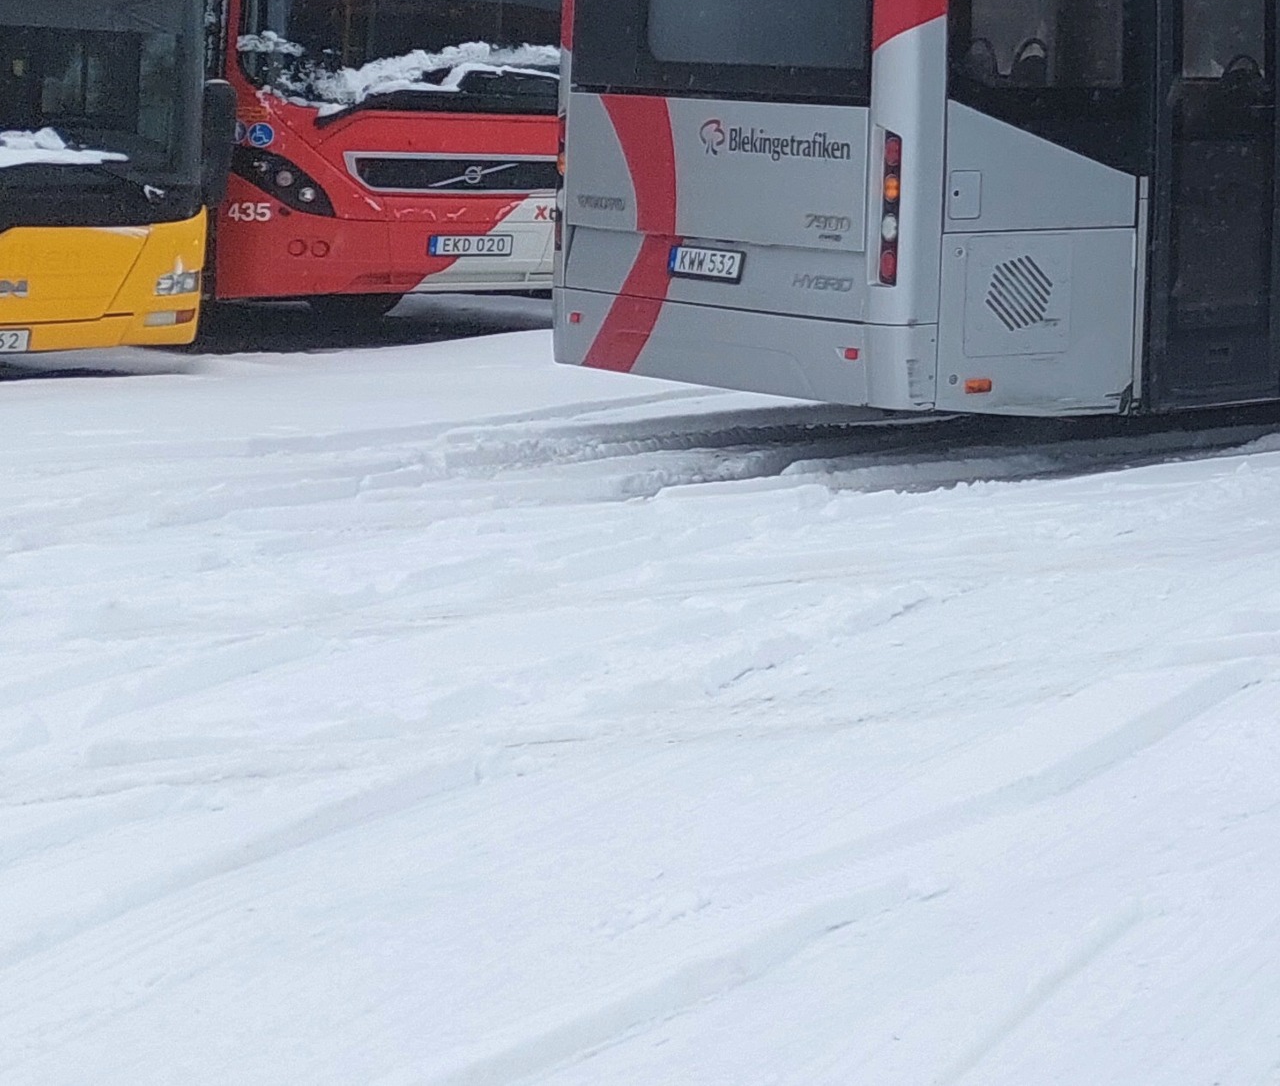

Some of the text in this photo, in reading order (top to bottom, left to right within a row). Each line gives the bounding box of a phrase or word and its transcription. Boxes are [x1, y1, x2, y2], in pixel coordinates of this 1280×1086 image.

[729, 127, 850, 161] Blekingetrafiken
[228, 202, 271, 221] 435
[443, 238, 505, 252] EKD 020
[679, 250, 735, 275] KWW 532
